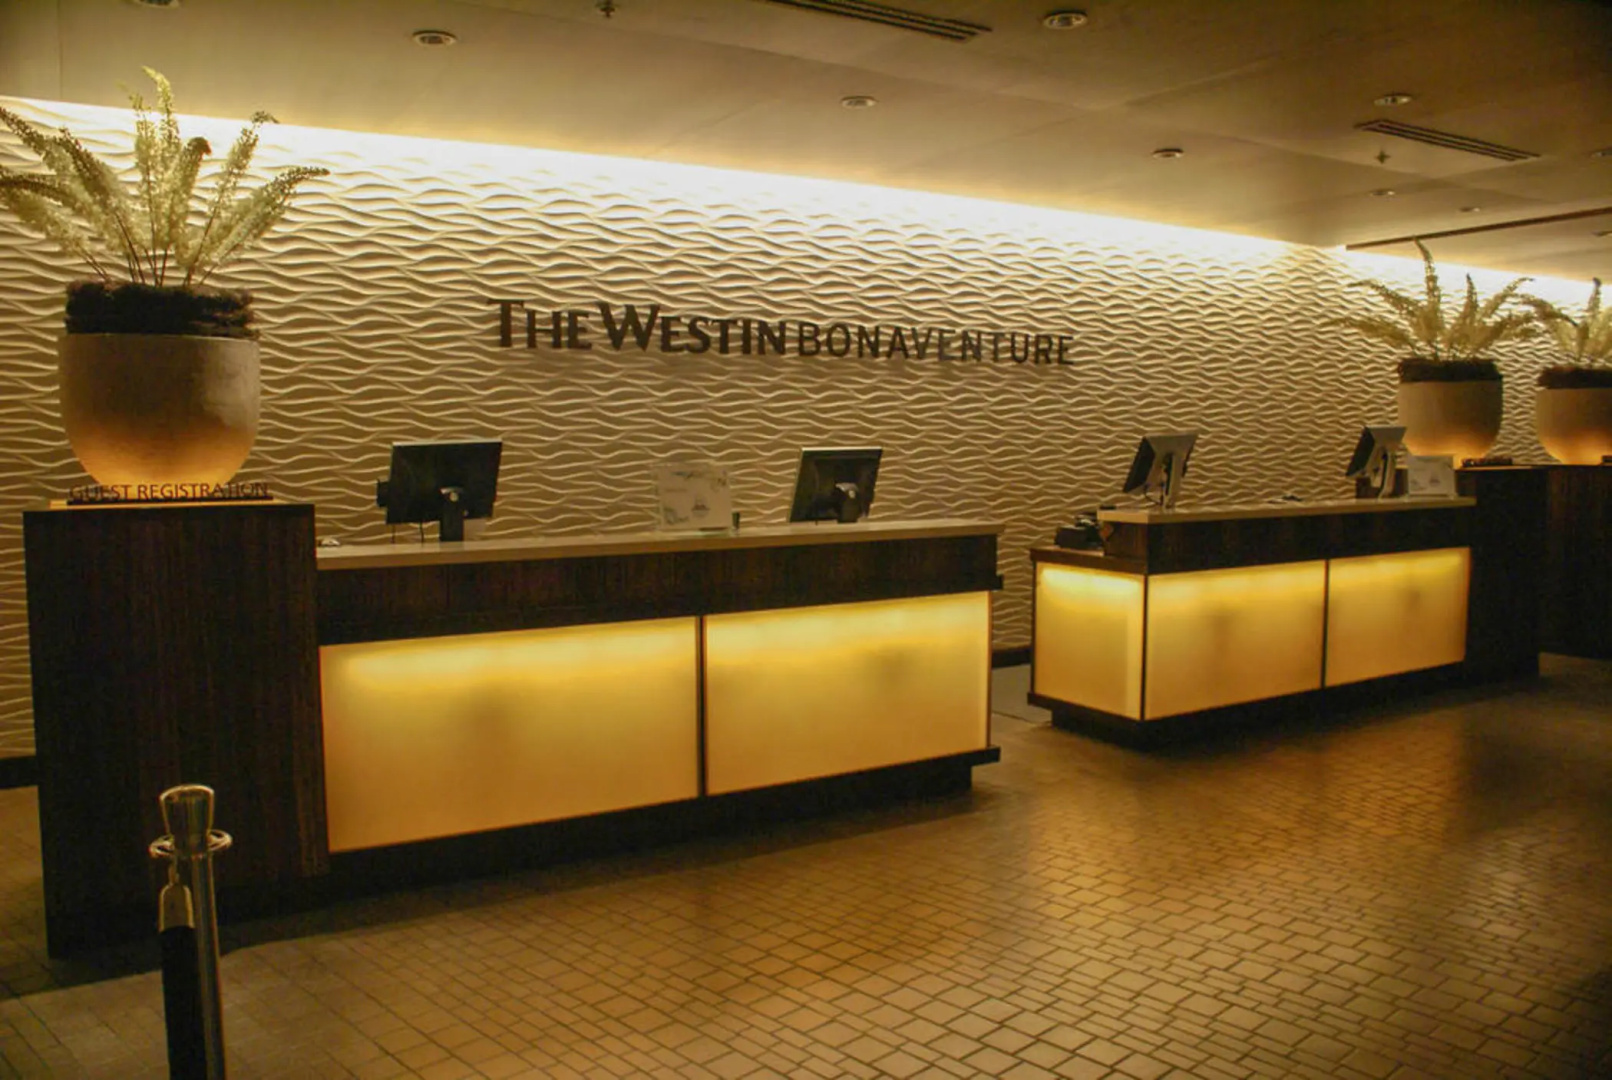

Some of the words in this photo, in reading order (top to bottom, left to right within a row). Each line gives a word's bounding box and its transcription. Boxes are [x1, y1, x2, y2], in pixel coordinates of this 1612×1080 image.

[798, 320, 1074, 365] BONAVENTURE
[69, 484, 131, 500] GUEST
[137, 482, 268, 499] REGISTRATION
